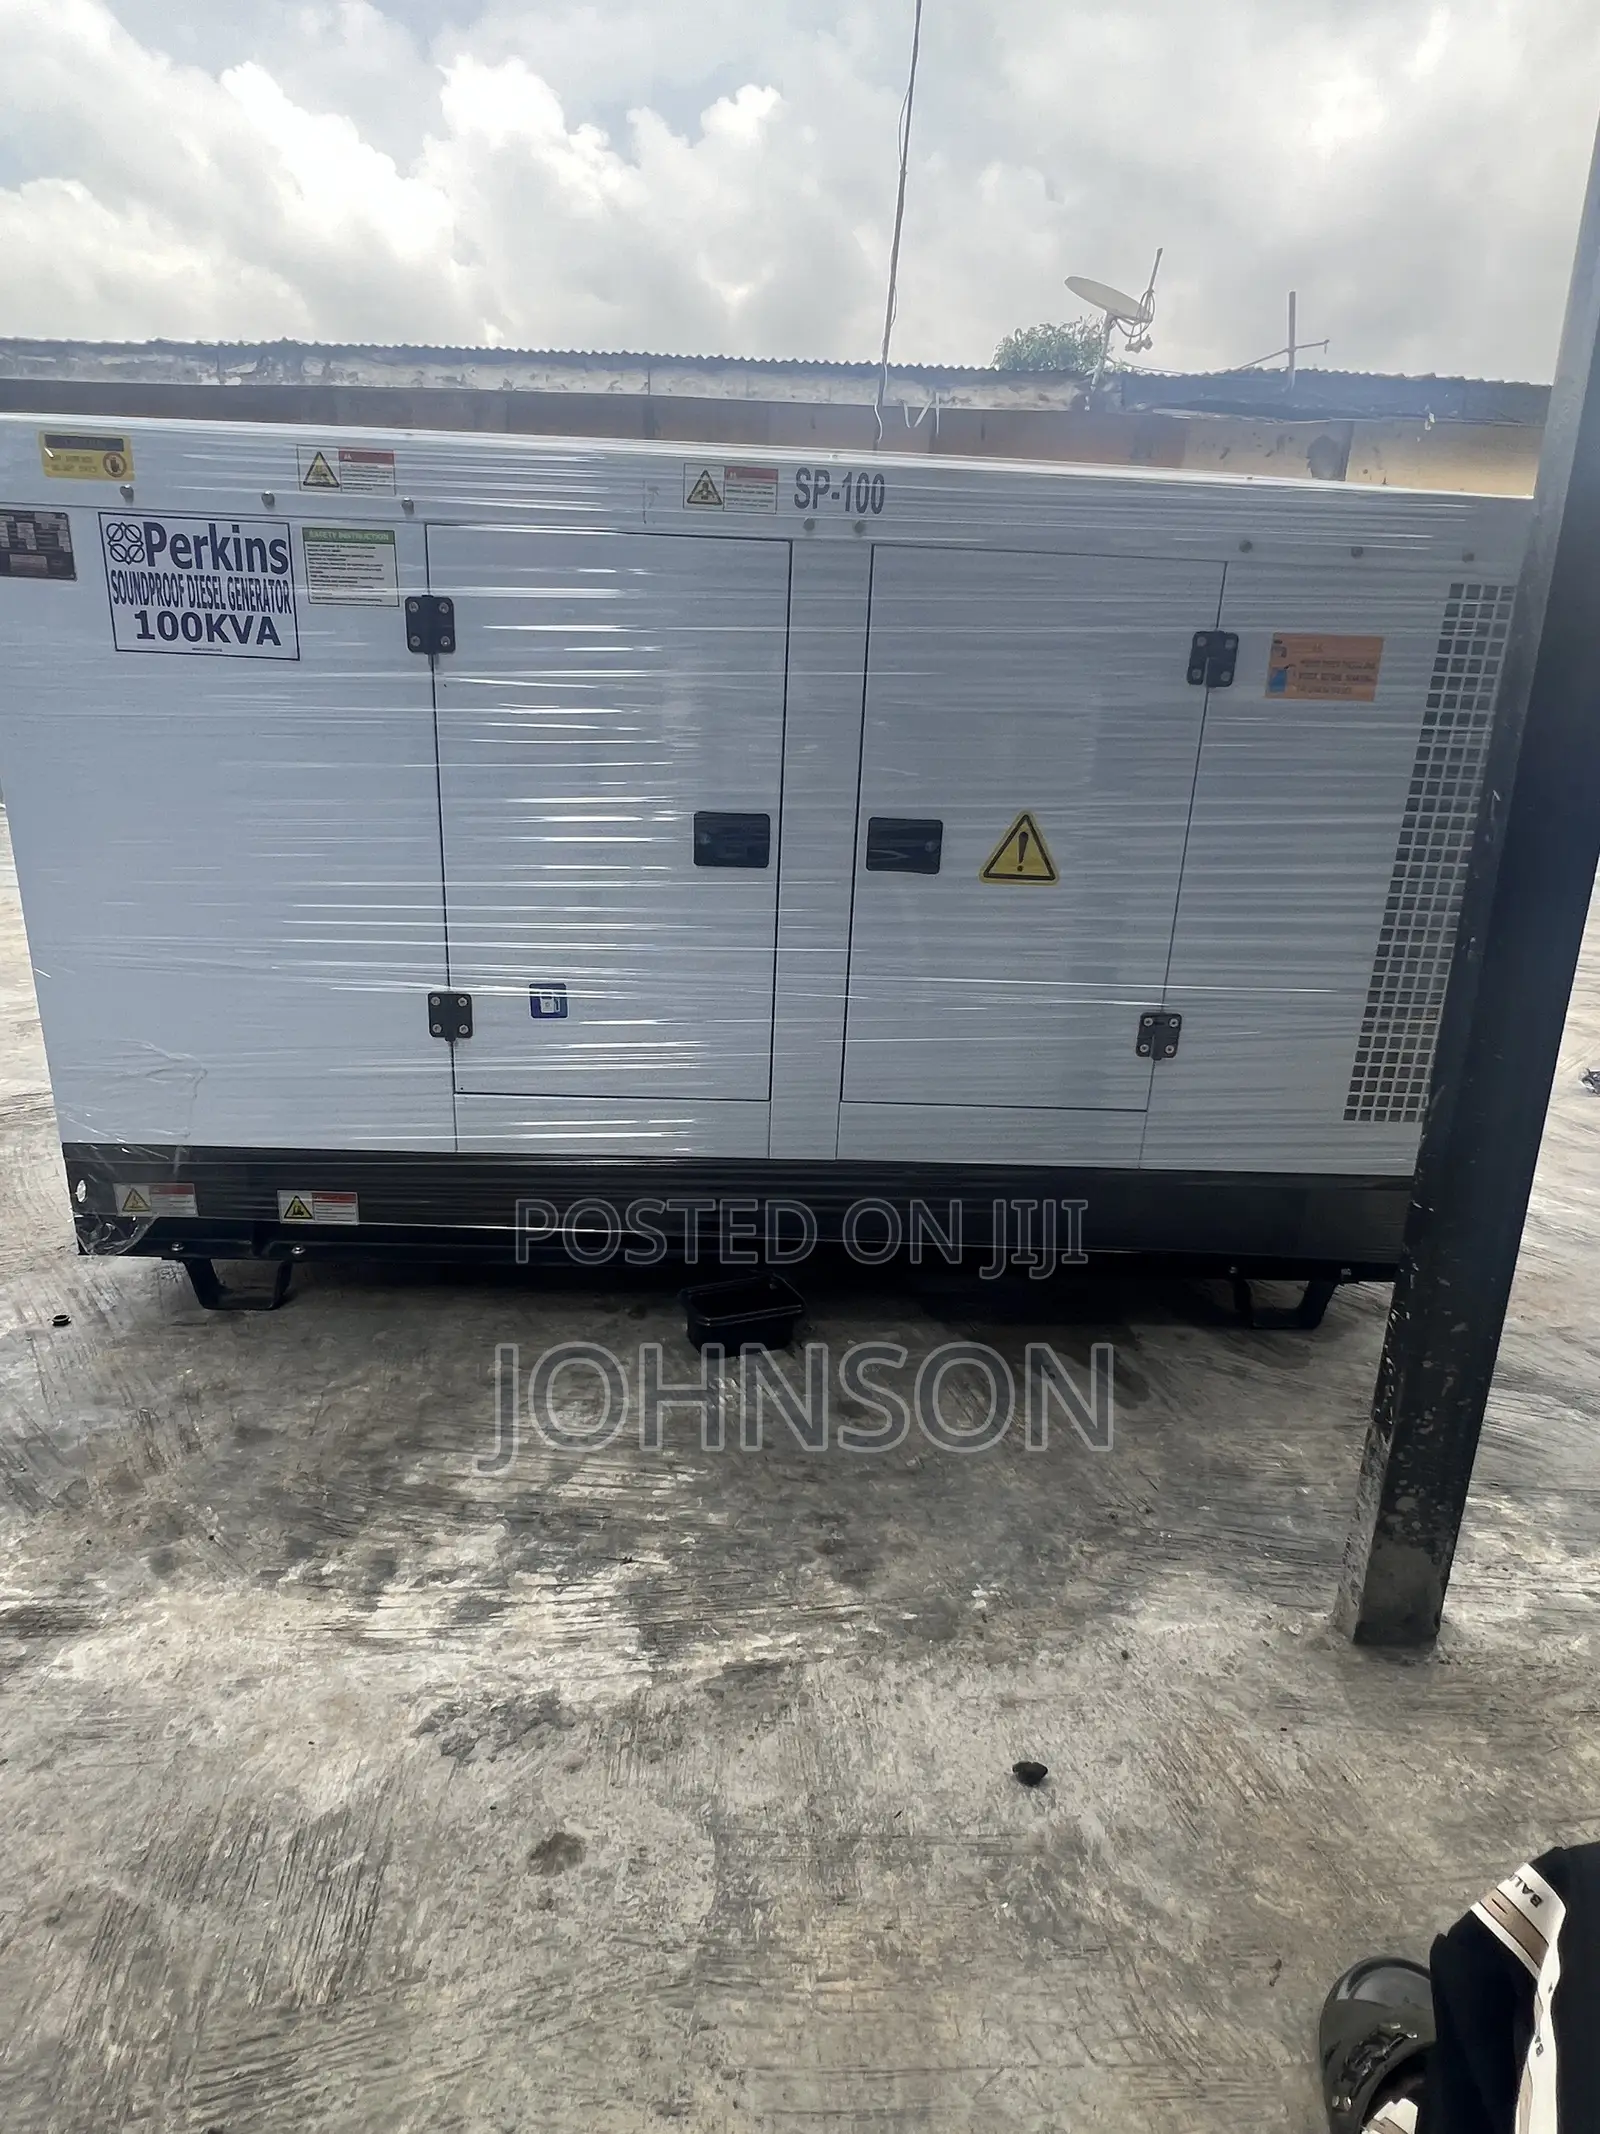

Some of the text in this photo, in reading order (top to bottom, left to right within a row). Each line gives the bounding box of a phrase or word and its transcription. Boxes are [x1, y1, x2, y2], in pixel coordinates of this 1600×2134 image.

[793, 467, 885, 515] SP-100
[143, 521, 289, 575] Perkins
[111, 570, 292, 614] SOUNDPROOF DIESEL GENERATOR
[134, 610, 281, 647] 100KVA
